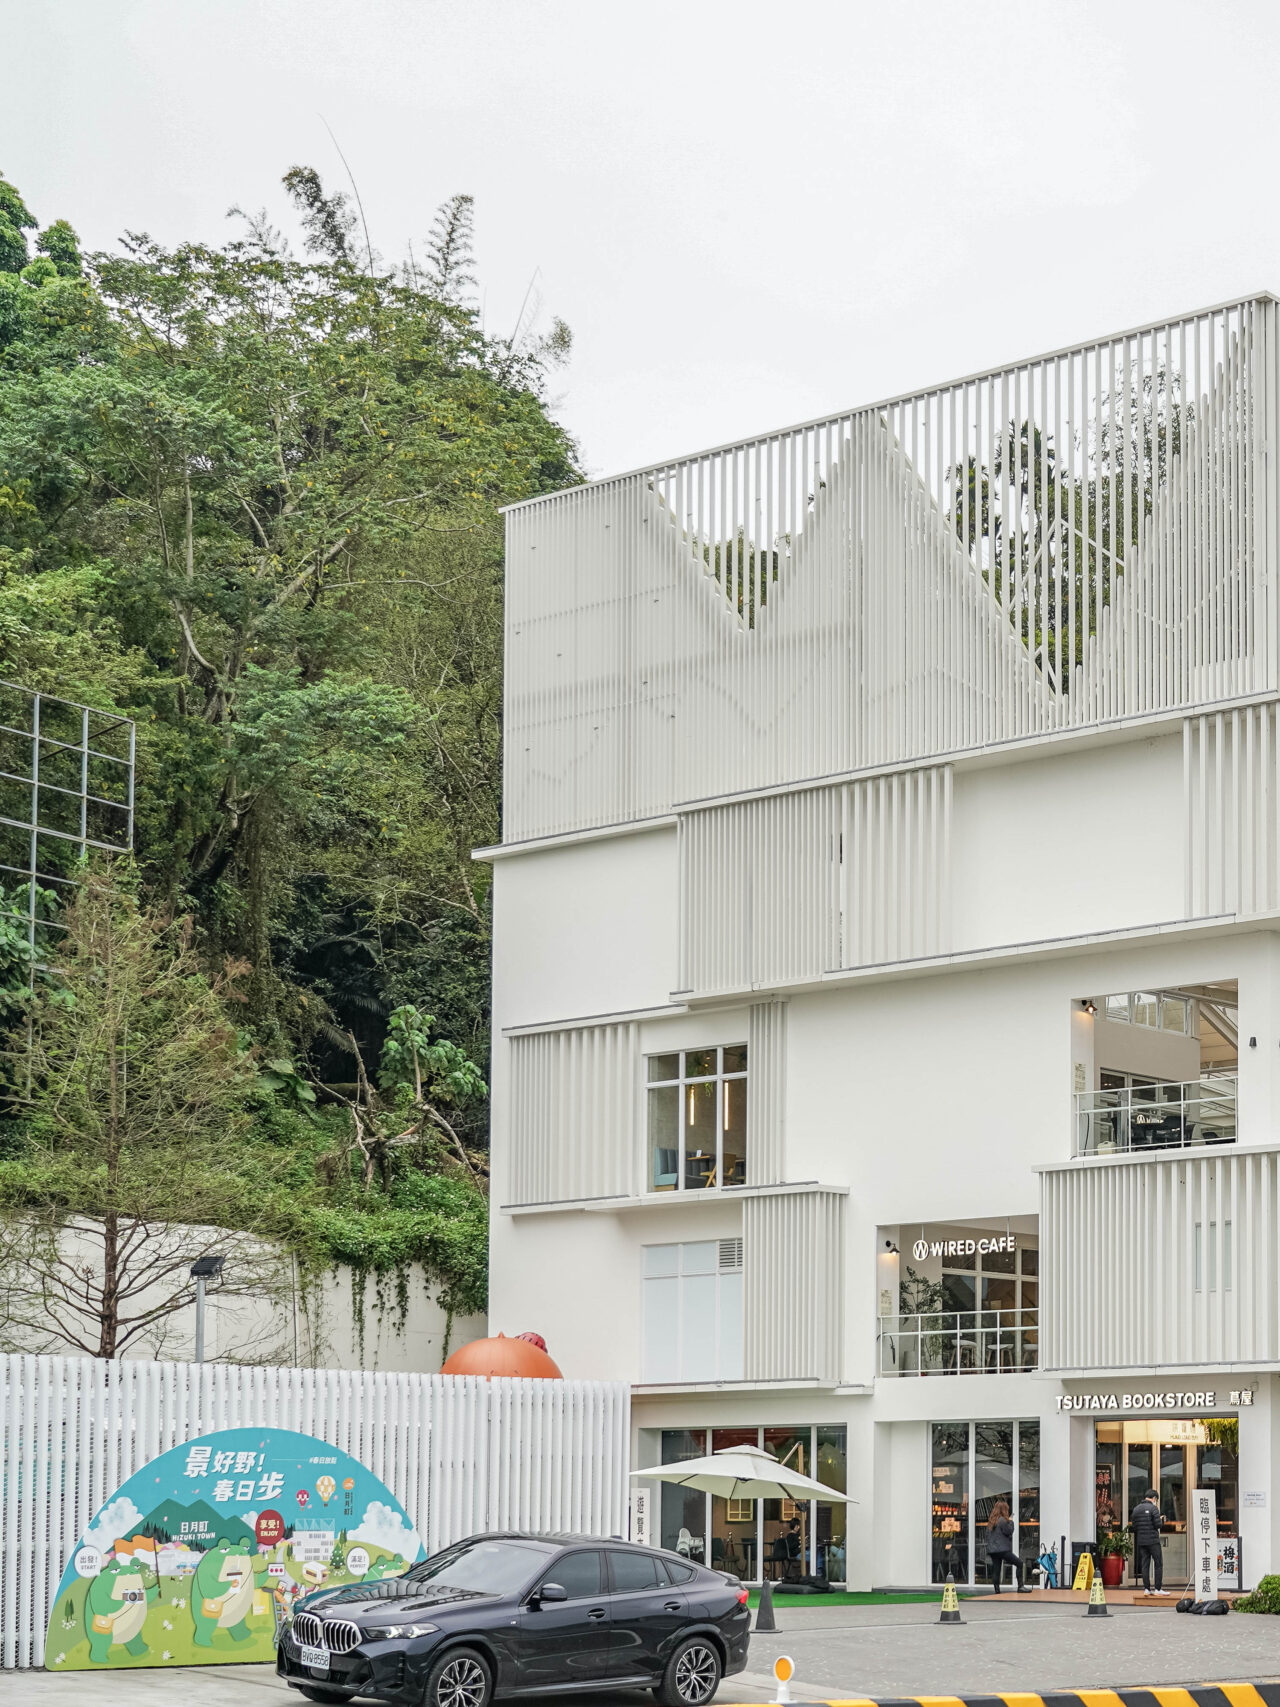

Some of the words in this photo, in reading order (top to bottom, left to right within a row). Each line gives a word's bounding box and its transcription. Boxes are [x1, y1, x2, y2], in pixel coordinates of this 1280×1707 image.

[931, 1240, 976, 1257] WIRED
[978, 1236, 1016, 1254] CAFE
[1056, 1394, 1119, 1410] TSUTAYA
[1122, 1391, 1216, 1408] BOOKSTORE
[1229, 1390, 1254, 1406] 蔦屋
[183, 1446, 266, 1478] 景好野!
[212, 1472, 285, 1502] 春日步
[180, 1521, 209, 1533] 日月町
[260, 1519, 280, 1529] 享受!
[172, 1534, 196, 1542] HIZUKI
[197, 1532, 216, 1540] TOWN
[1199, 1497, 1211, 1593] 臨停下車處
[1223, 1545, 1235, 1574] 梅酒
